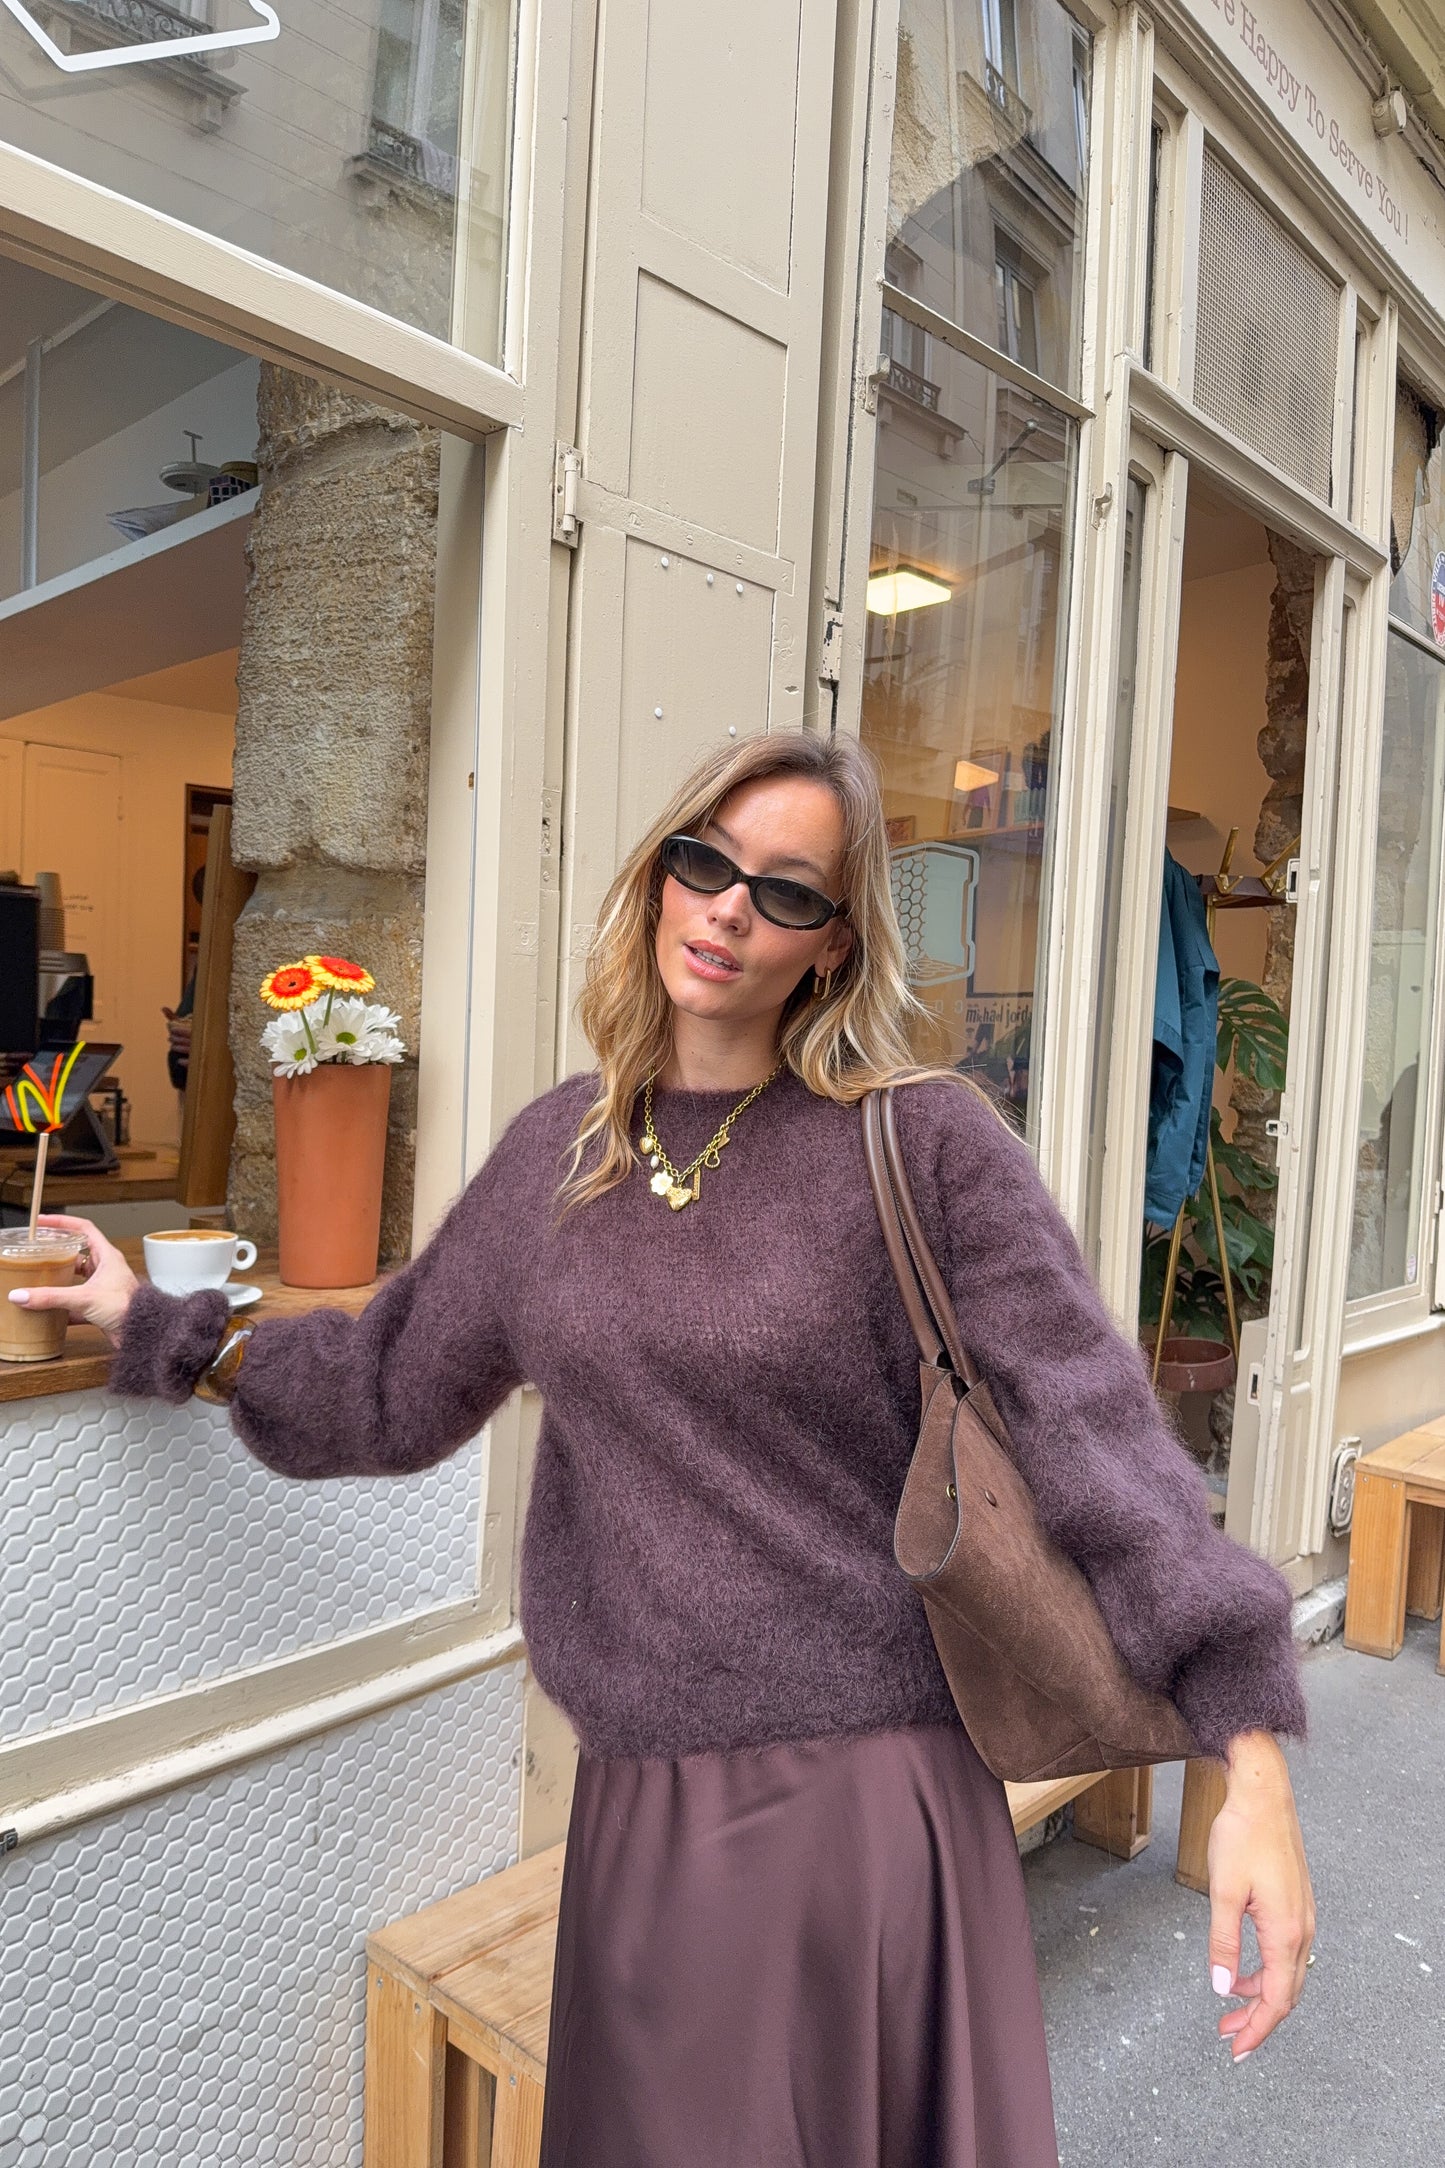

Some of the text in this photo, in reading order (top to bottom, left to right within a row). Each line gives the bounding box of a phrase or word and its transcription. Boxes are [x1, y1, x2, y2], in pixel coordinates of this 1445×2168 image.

[1240, 0, 1301, 113] Happy
[1305, 84, 1325, 140] To
[1329, 118, 1373, 199] Serve
